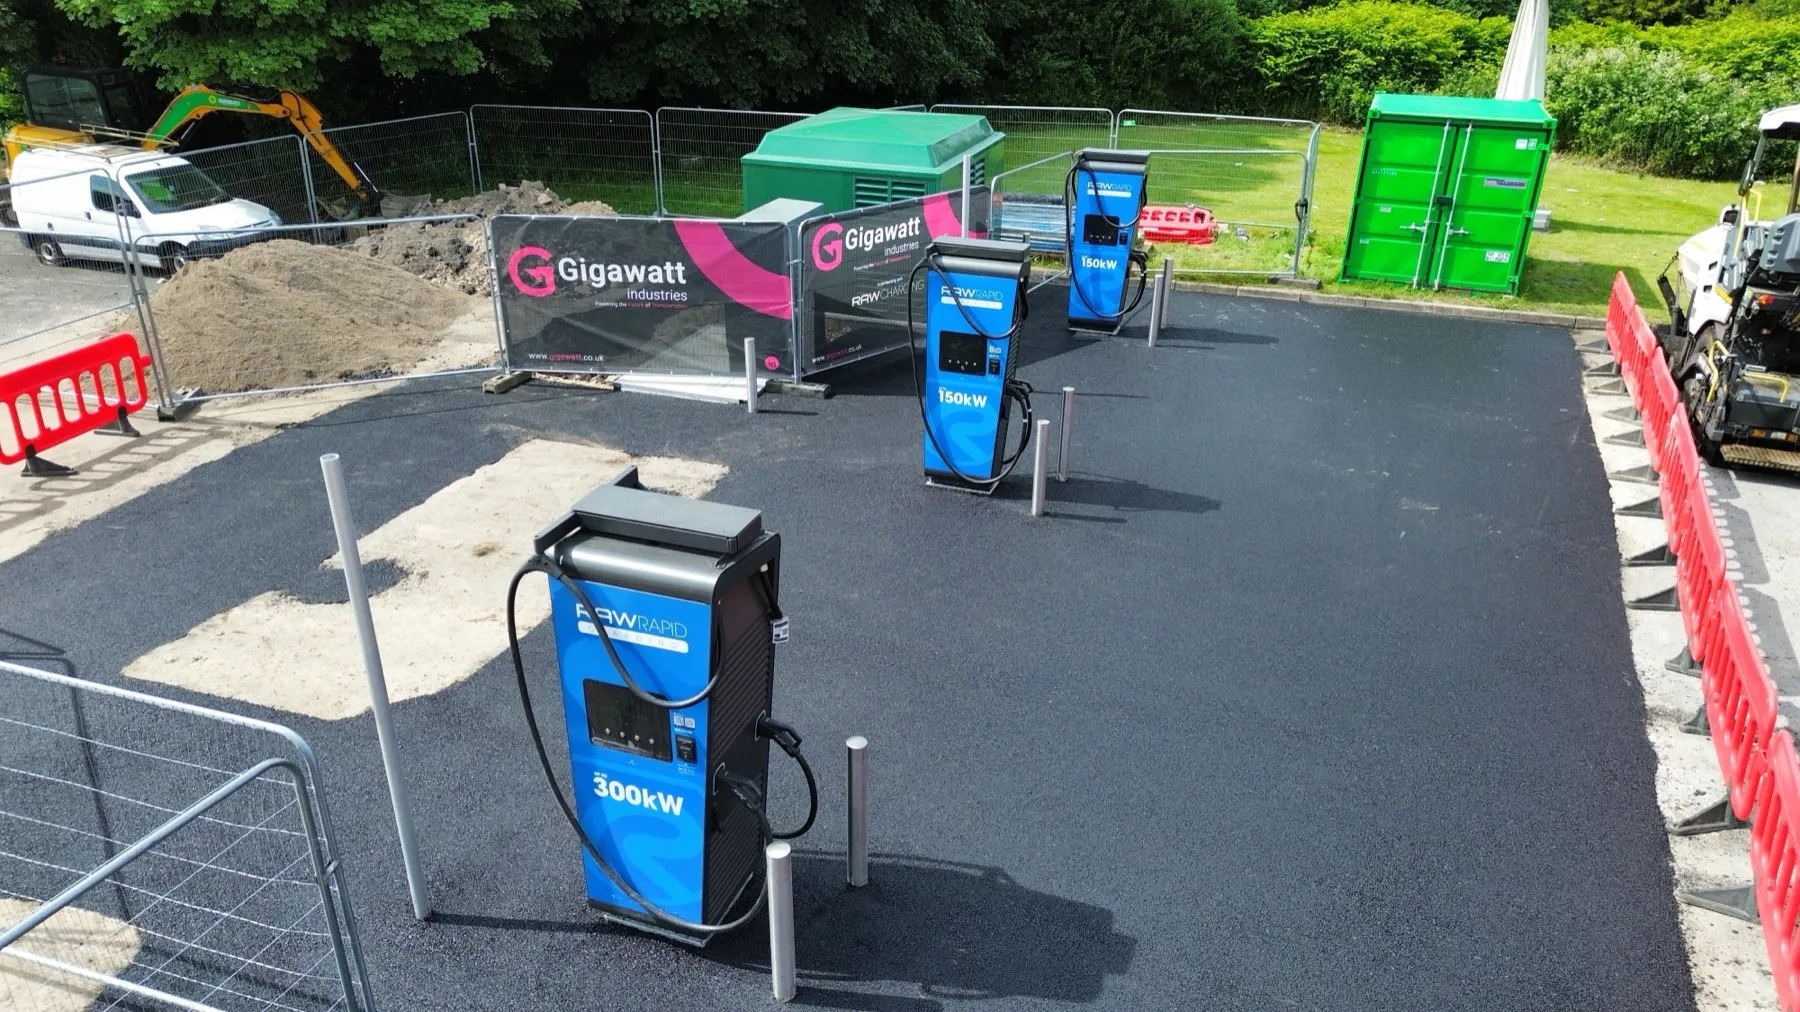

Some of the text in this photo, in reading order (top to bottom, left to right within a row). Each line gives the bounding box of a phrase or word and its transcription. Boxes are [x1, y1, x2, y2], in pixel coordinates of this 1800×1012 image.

[845, 216, 921, 252] Gigawatt
[884, 240, 920, 257] industries
[558, 257, 687, 288] Gigawatt
[1081, 256, 1118, 270] 150kW
[627, 287, 688, 302] industries
[851, 279, 925, 308] RAWCHARGNG
[528, 353, 605, 362] www.gigawatt.co.uk
[938, 389, 988, 408] 150kW
[588, 625, 679, 650] CARGING
[593, 776, 684, 816] 300kW
